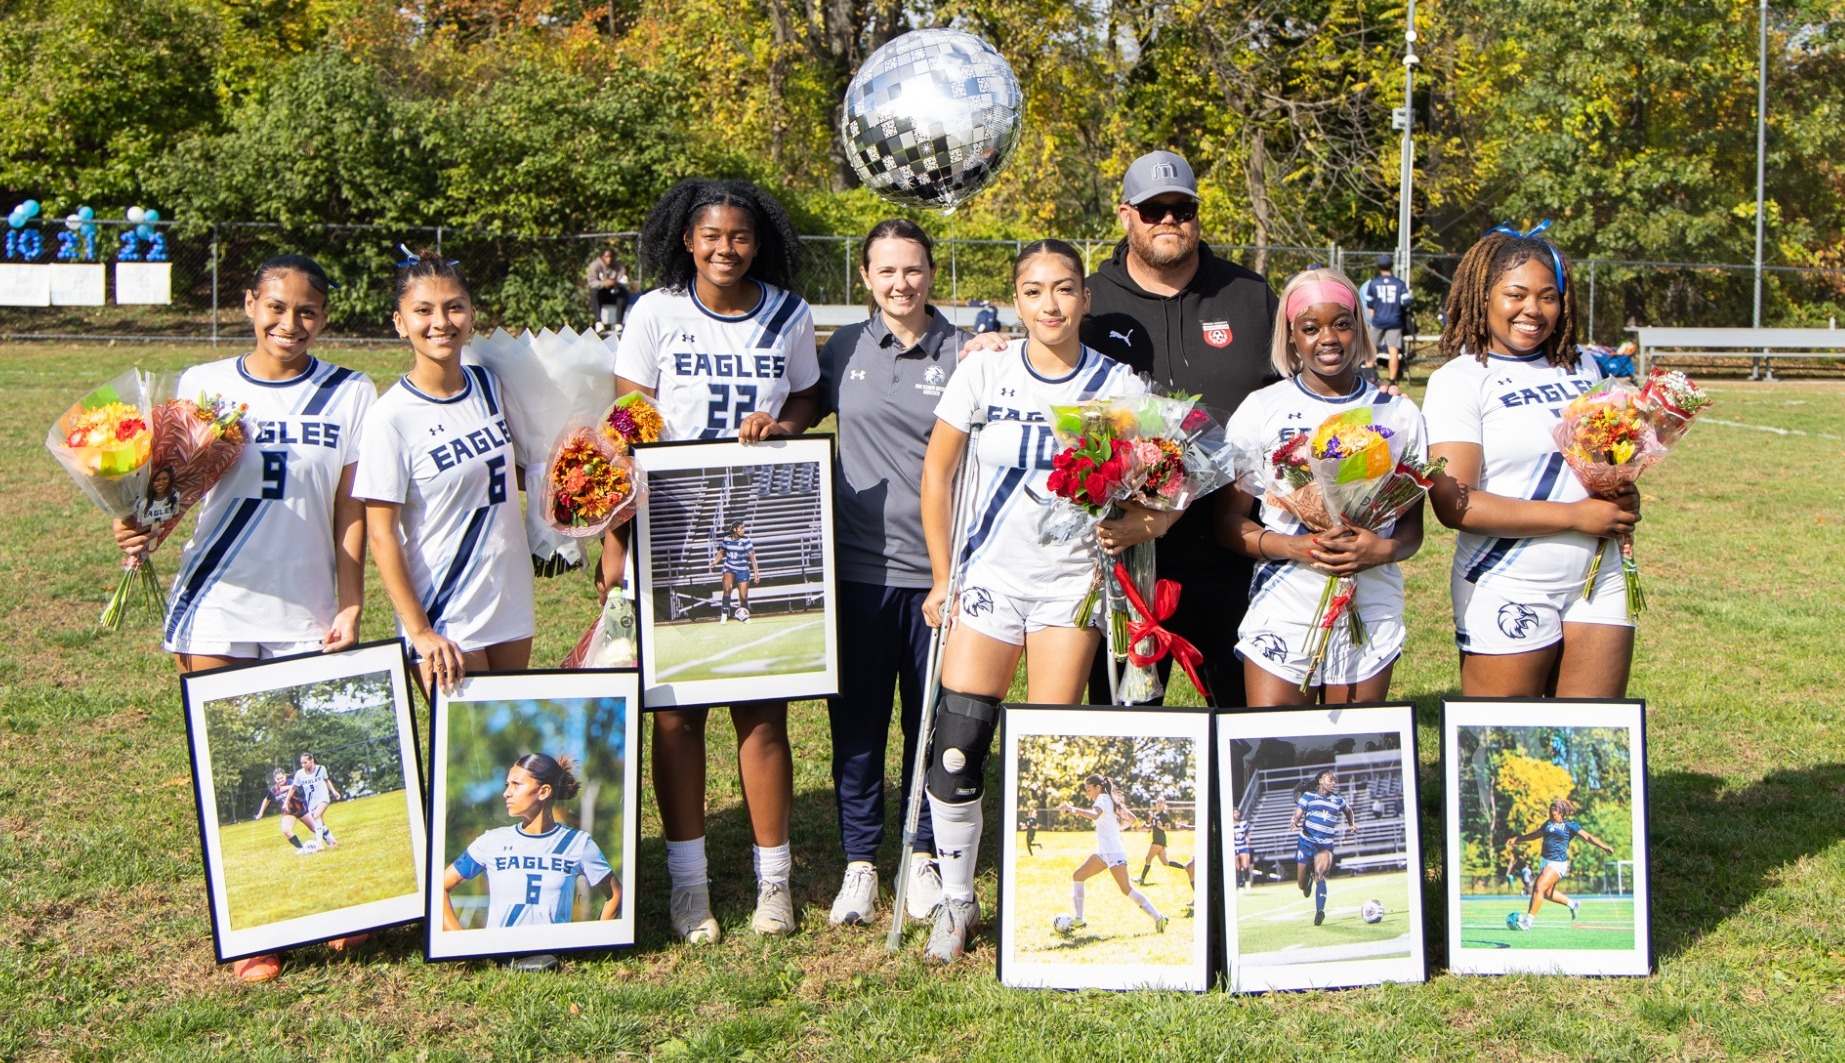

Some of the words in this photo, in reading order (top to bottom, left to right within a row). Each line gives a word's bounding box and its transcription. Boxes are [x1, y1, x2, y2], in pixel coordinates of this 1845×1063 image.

[6, 229, 43, 261] 10
[57, 230, 96, 261] 21
[118, 230, 168, 262] 22
[1376, 285, 1397, 303] 45
[673, 353, 785, 379] EAGLES
[707, 383, 758, 429] 22
[1498, 379, 1593, 408] EAGLE
[254, 421, 341, 450] GLES
[428, 420, 513, 473] EAGLE
[1018, 425, 1060, 471] 10
[260, 451, 288, 500] 9
[485, 454, 507, 506] 6
[495, 856, 575, 874] EAGLES
[526, 874, 543, 905] 6
